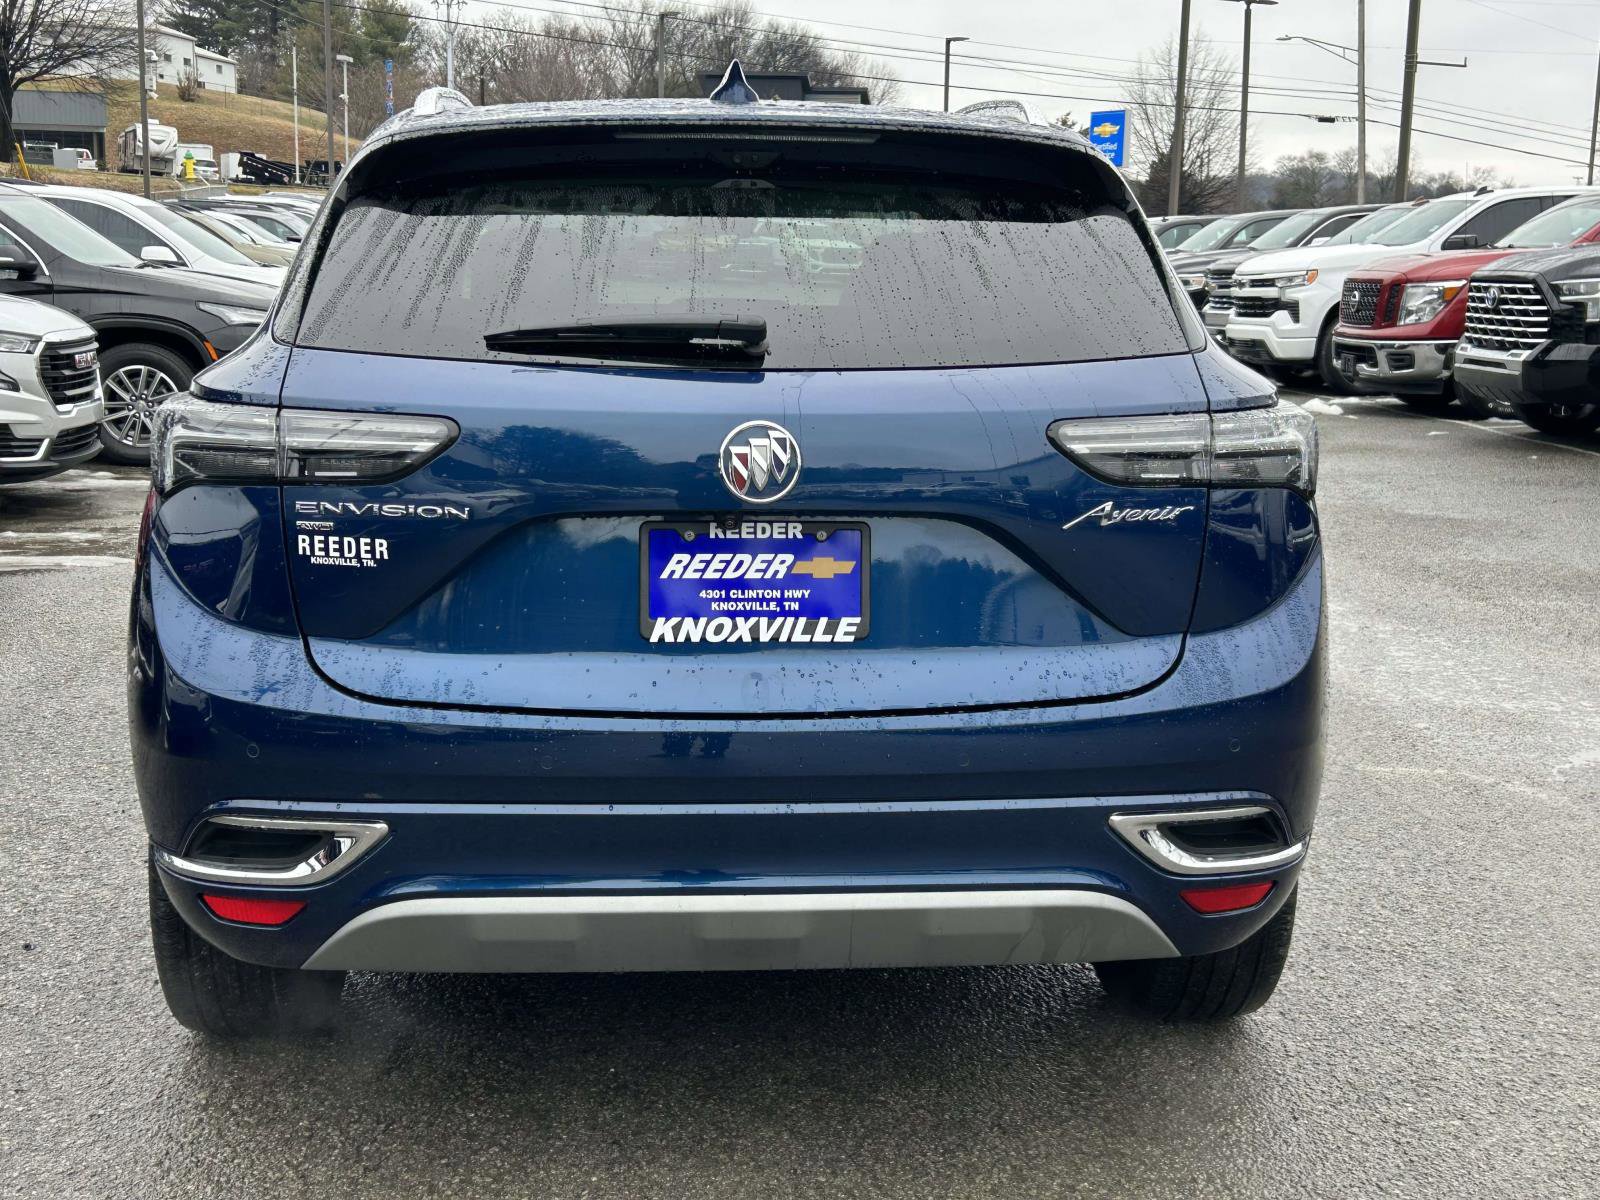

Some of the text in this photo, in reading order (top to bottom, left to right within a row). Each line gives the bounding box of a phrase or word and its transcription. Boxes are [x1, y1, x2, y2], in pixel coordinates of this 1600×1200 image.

[295, 501, 470, 520] ENVISION
[1061, 501, 1195, 531] Avenir
[296, 521, 334, 531] AWD
[709, 522, 804, 539] REEDER
[298, 534, 389, 560] REEDER
[311, 556, 377, 568] KNOXVILLE, TN.
[660, 553, 795, 580] REEDER
[699, 589, 811, 599] 4301 CLINTON HWY
[711, 601, 800, 612] KNOXVILLE, TN
[649, 616, 862, 643] KNOXVILLE
